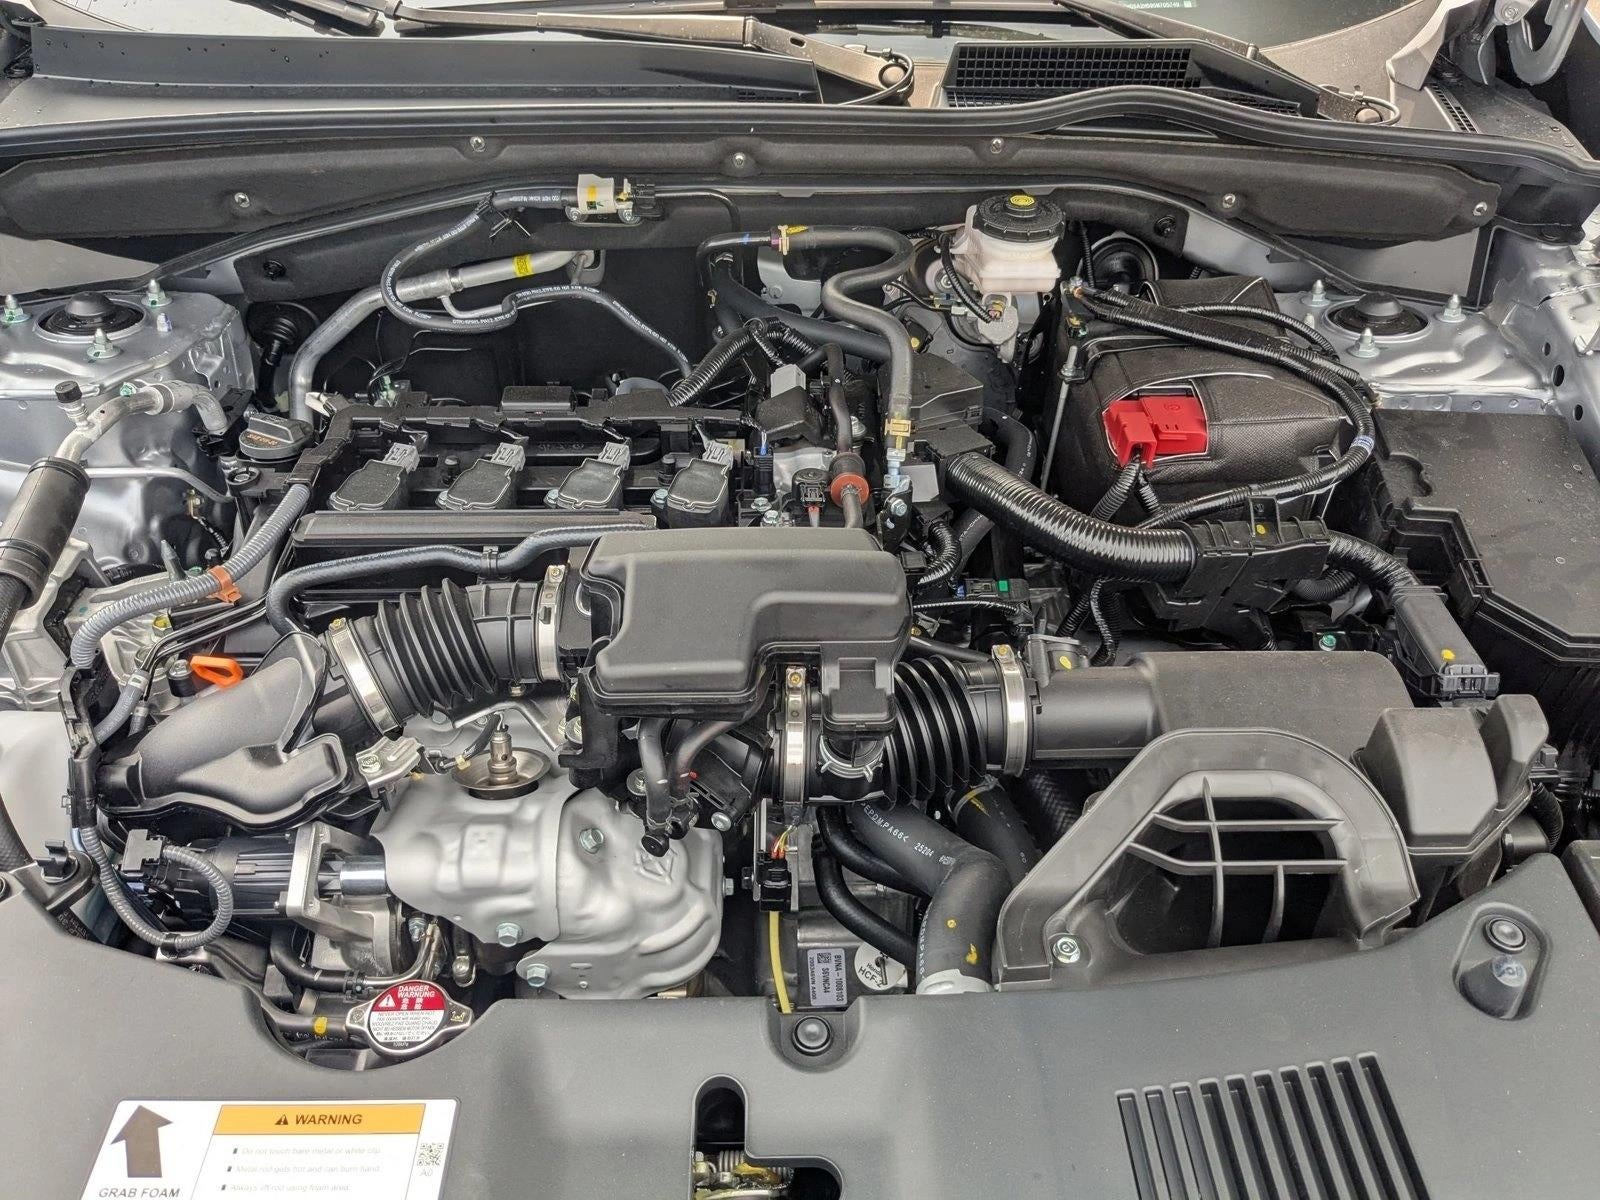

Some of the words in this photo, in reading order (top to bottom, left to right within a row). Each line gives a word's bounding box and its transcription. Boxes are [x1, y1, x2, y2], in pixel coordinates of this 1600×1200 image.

[295, 1114, 362, 1125] WARNING
[98, 1187, 138, 1198] GRAB
[140, 1187, 180, 1198] FOAM
